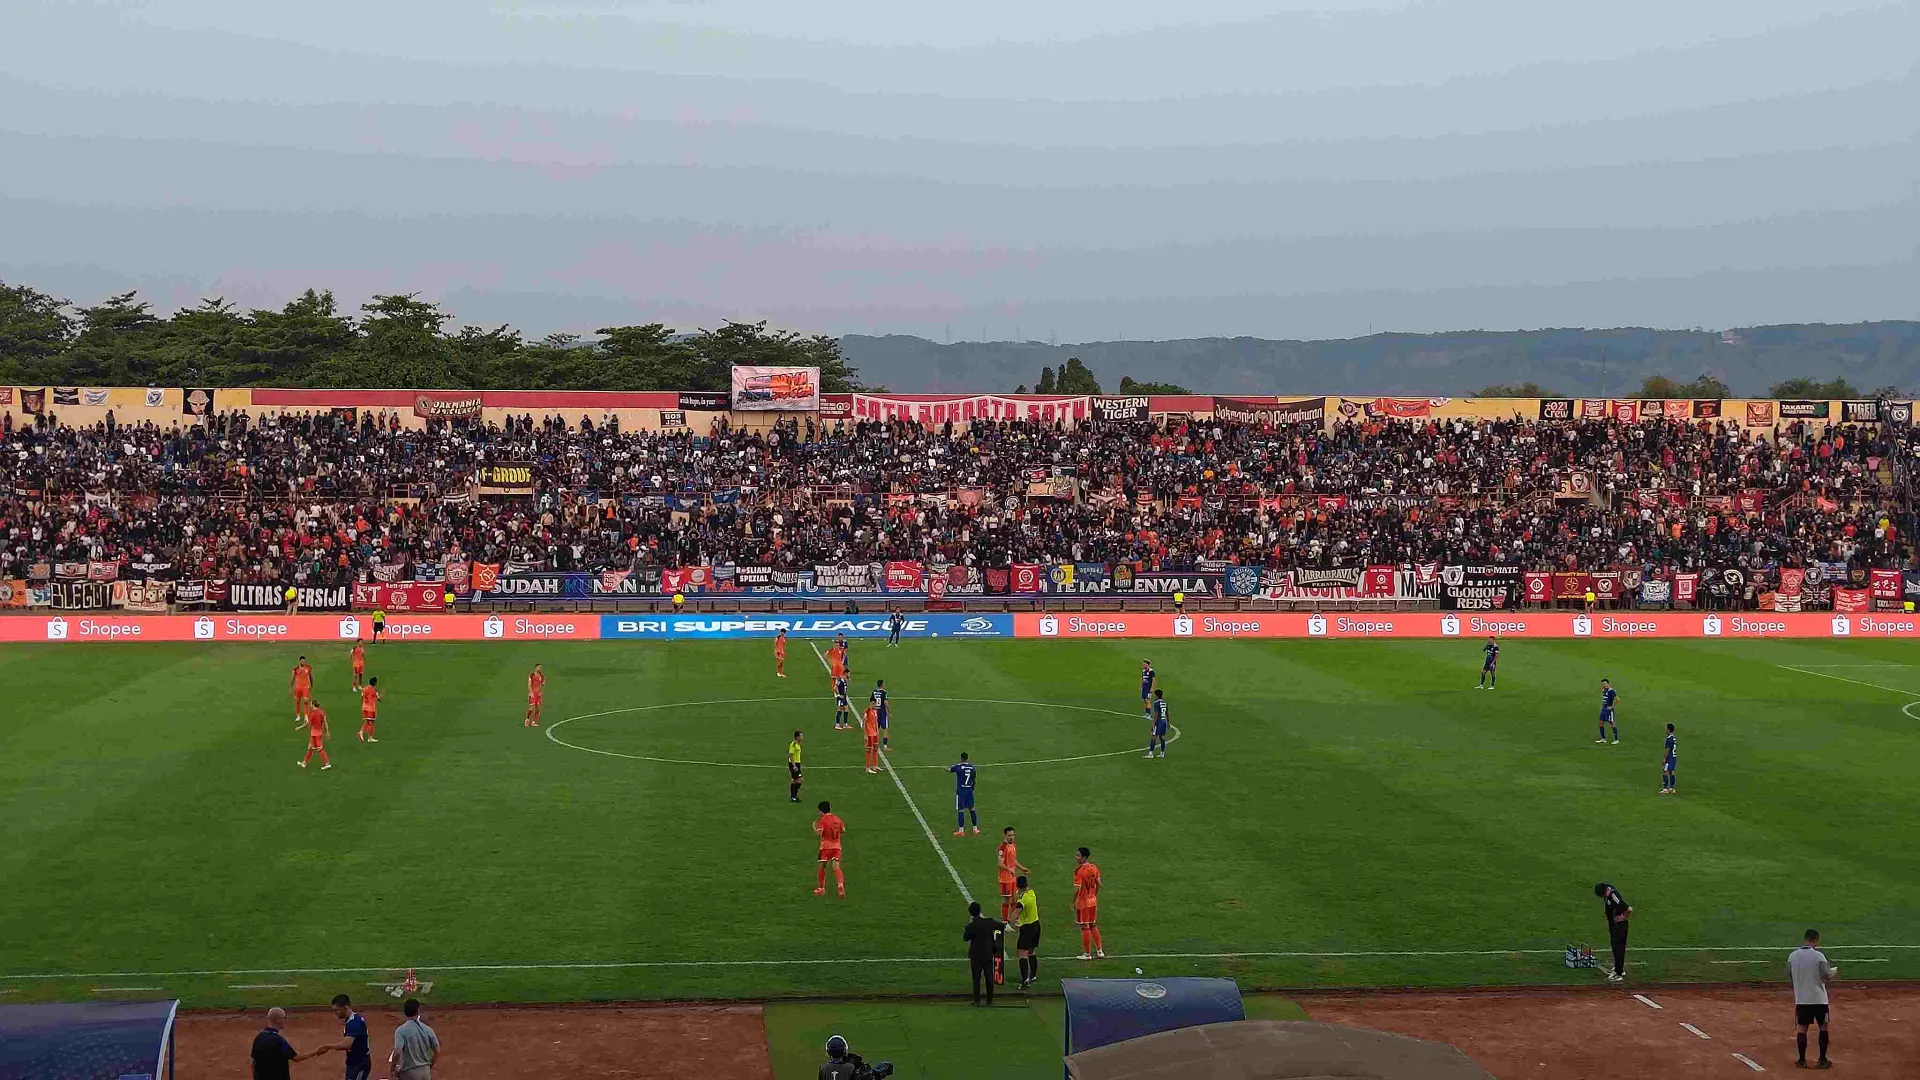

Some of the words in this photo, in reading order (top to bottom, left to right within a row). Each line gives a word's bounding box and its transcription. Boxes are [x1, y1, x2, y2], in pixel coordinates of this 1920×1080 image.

[1093, 398, 1149, 410] WESTERN
[1102, 407, 1138, 420] TIGER
[231, 584, 282, 606] ULTRAS
[490, 579, 559, 594] SUDAH
[1116, 579, 1208, 593] ENYALA
[1447, 586, 1508, 599] GLORIOUS
[1456, 598, 1492, 609] REDS
[80, 619, 140, 639] Shopee
[226, 619, 287, 639] Shopee
[371, 619, 432, 639] hopee
[515, 619, 575, 638] Shopee
[618, 621, 667, 632] BRI
[673, 620, 790, 632] SUPER
[793, 620, 930, 631] LEAGUE
[1069, 617, 1126, 636] Shopee
[1203, 617, 1260, 635] Shopee
[1337, 617, 1393, 635] Shopee
[1470, 617, 1526, 635] Shopee
[1602, 617, 1657, 635] Shopee
[1731, 617, 1785, 635] Shopee
[1859, 617, 1914, 635] Shopee
[964, 773, 971, 786] 7
